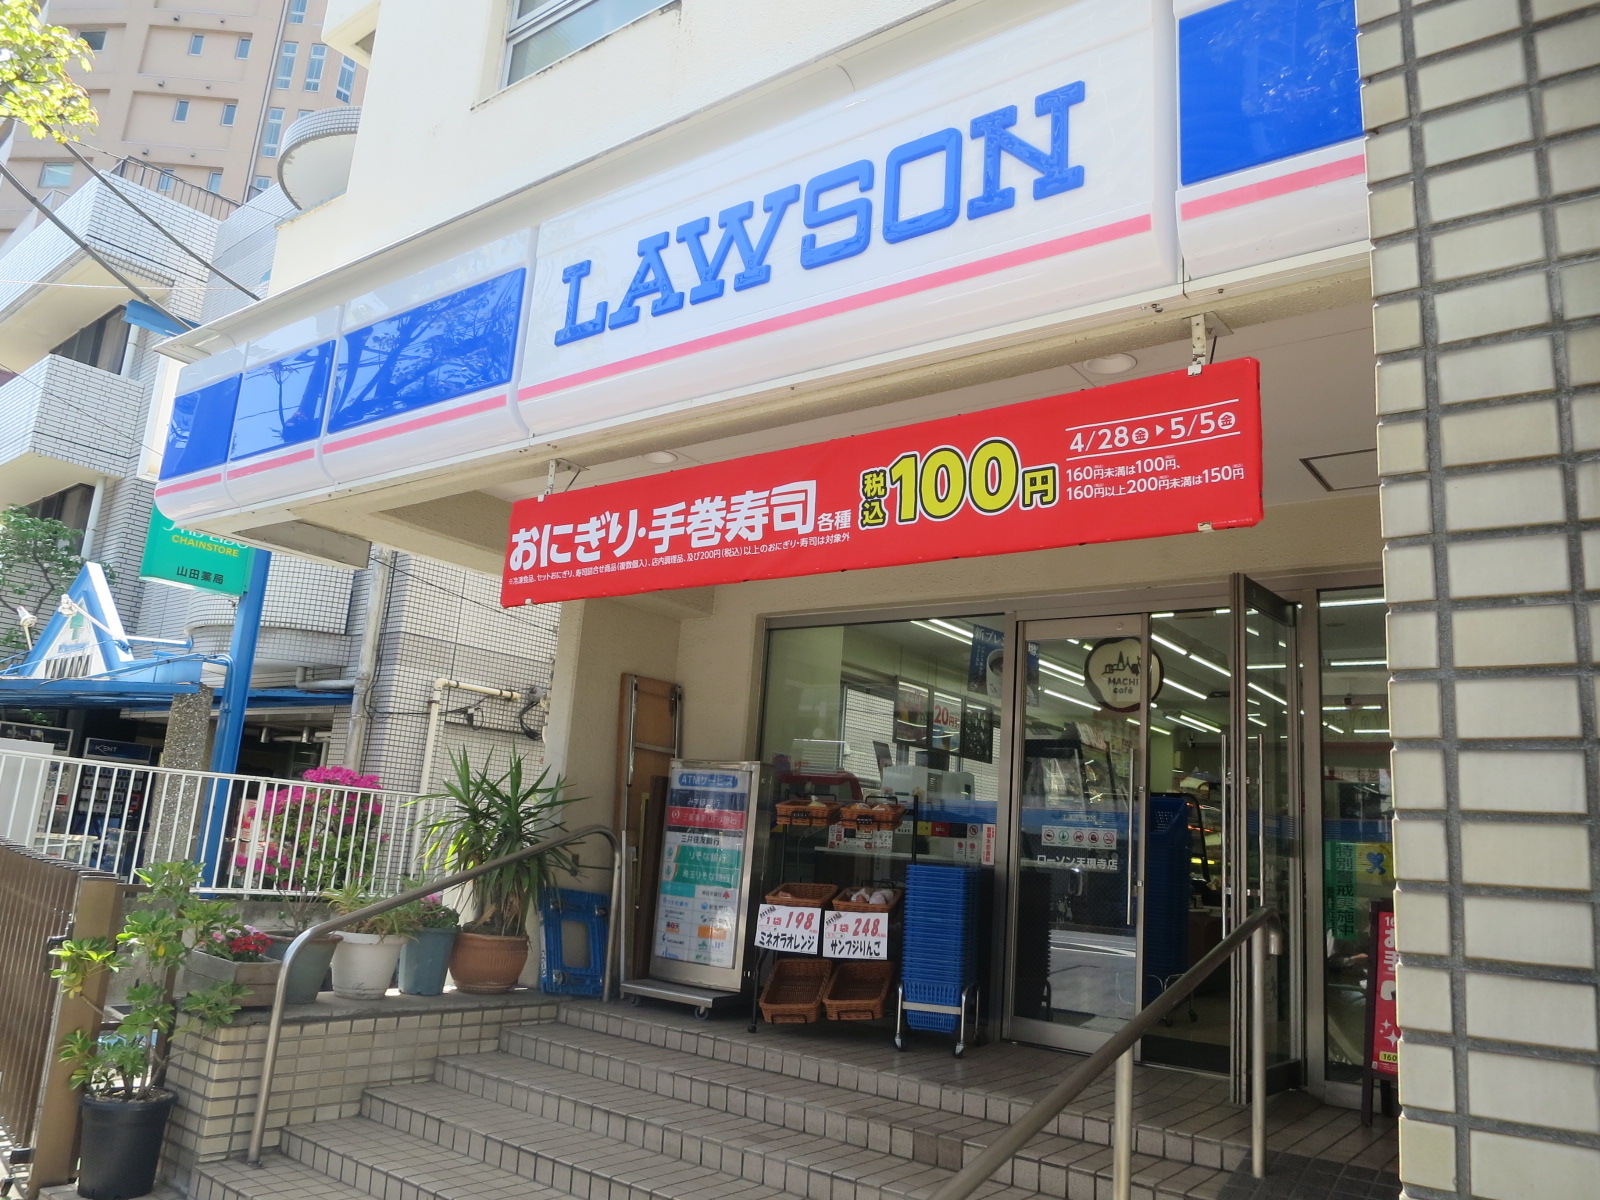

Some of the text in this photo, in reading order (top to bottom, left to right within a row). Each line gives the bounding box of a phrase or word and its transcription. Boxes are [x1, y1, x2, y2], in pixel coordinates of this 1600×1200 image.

[554, 80, 1085, 347] LAWSON
[888, 437, 1058, 522] 100円
[171, 534, 239, 557] CHAINSTORE
[176, 566, 224, 585] 山田薬局
[1107, 677, 1139, 686] MACHI
[681, 774, 733, 787] ATMサービス
[681, 834, 720, 846] 三井住友銀行
[688, 851, 727, 863] りそな銀行
[1037, 855, 1118, 871] ローソン天現寺店
[785, 911, 815, 930] 198
[852, 917, 880, 937] 248
[759, 931, 815, 950] ミネオラオレンジ
[830, 939, 881, 957] サンフジりんご
